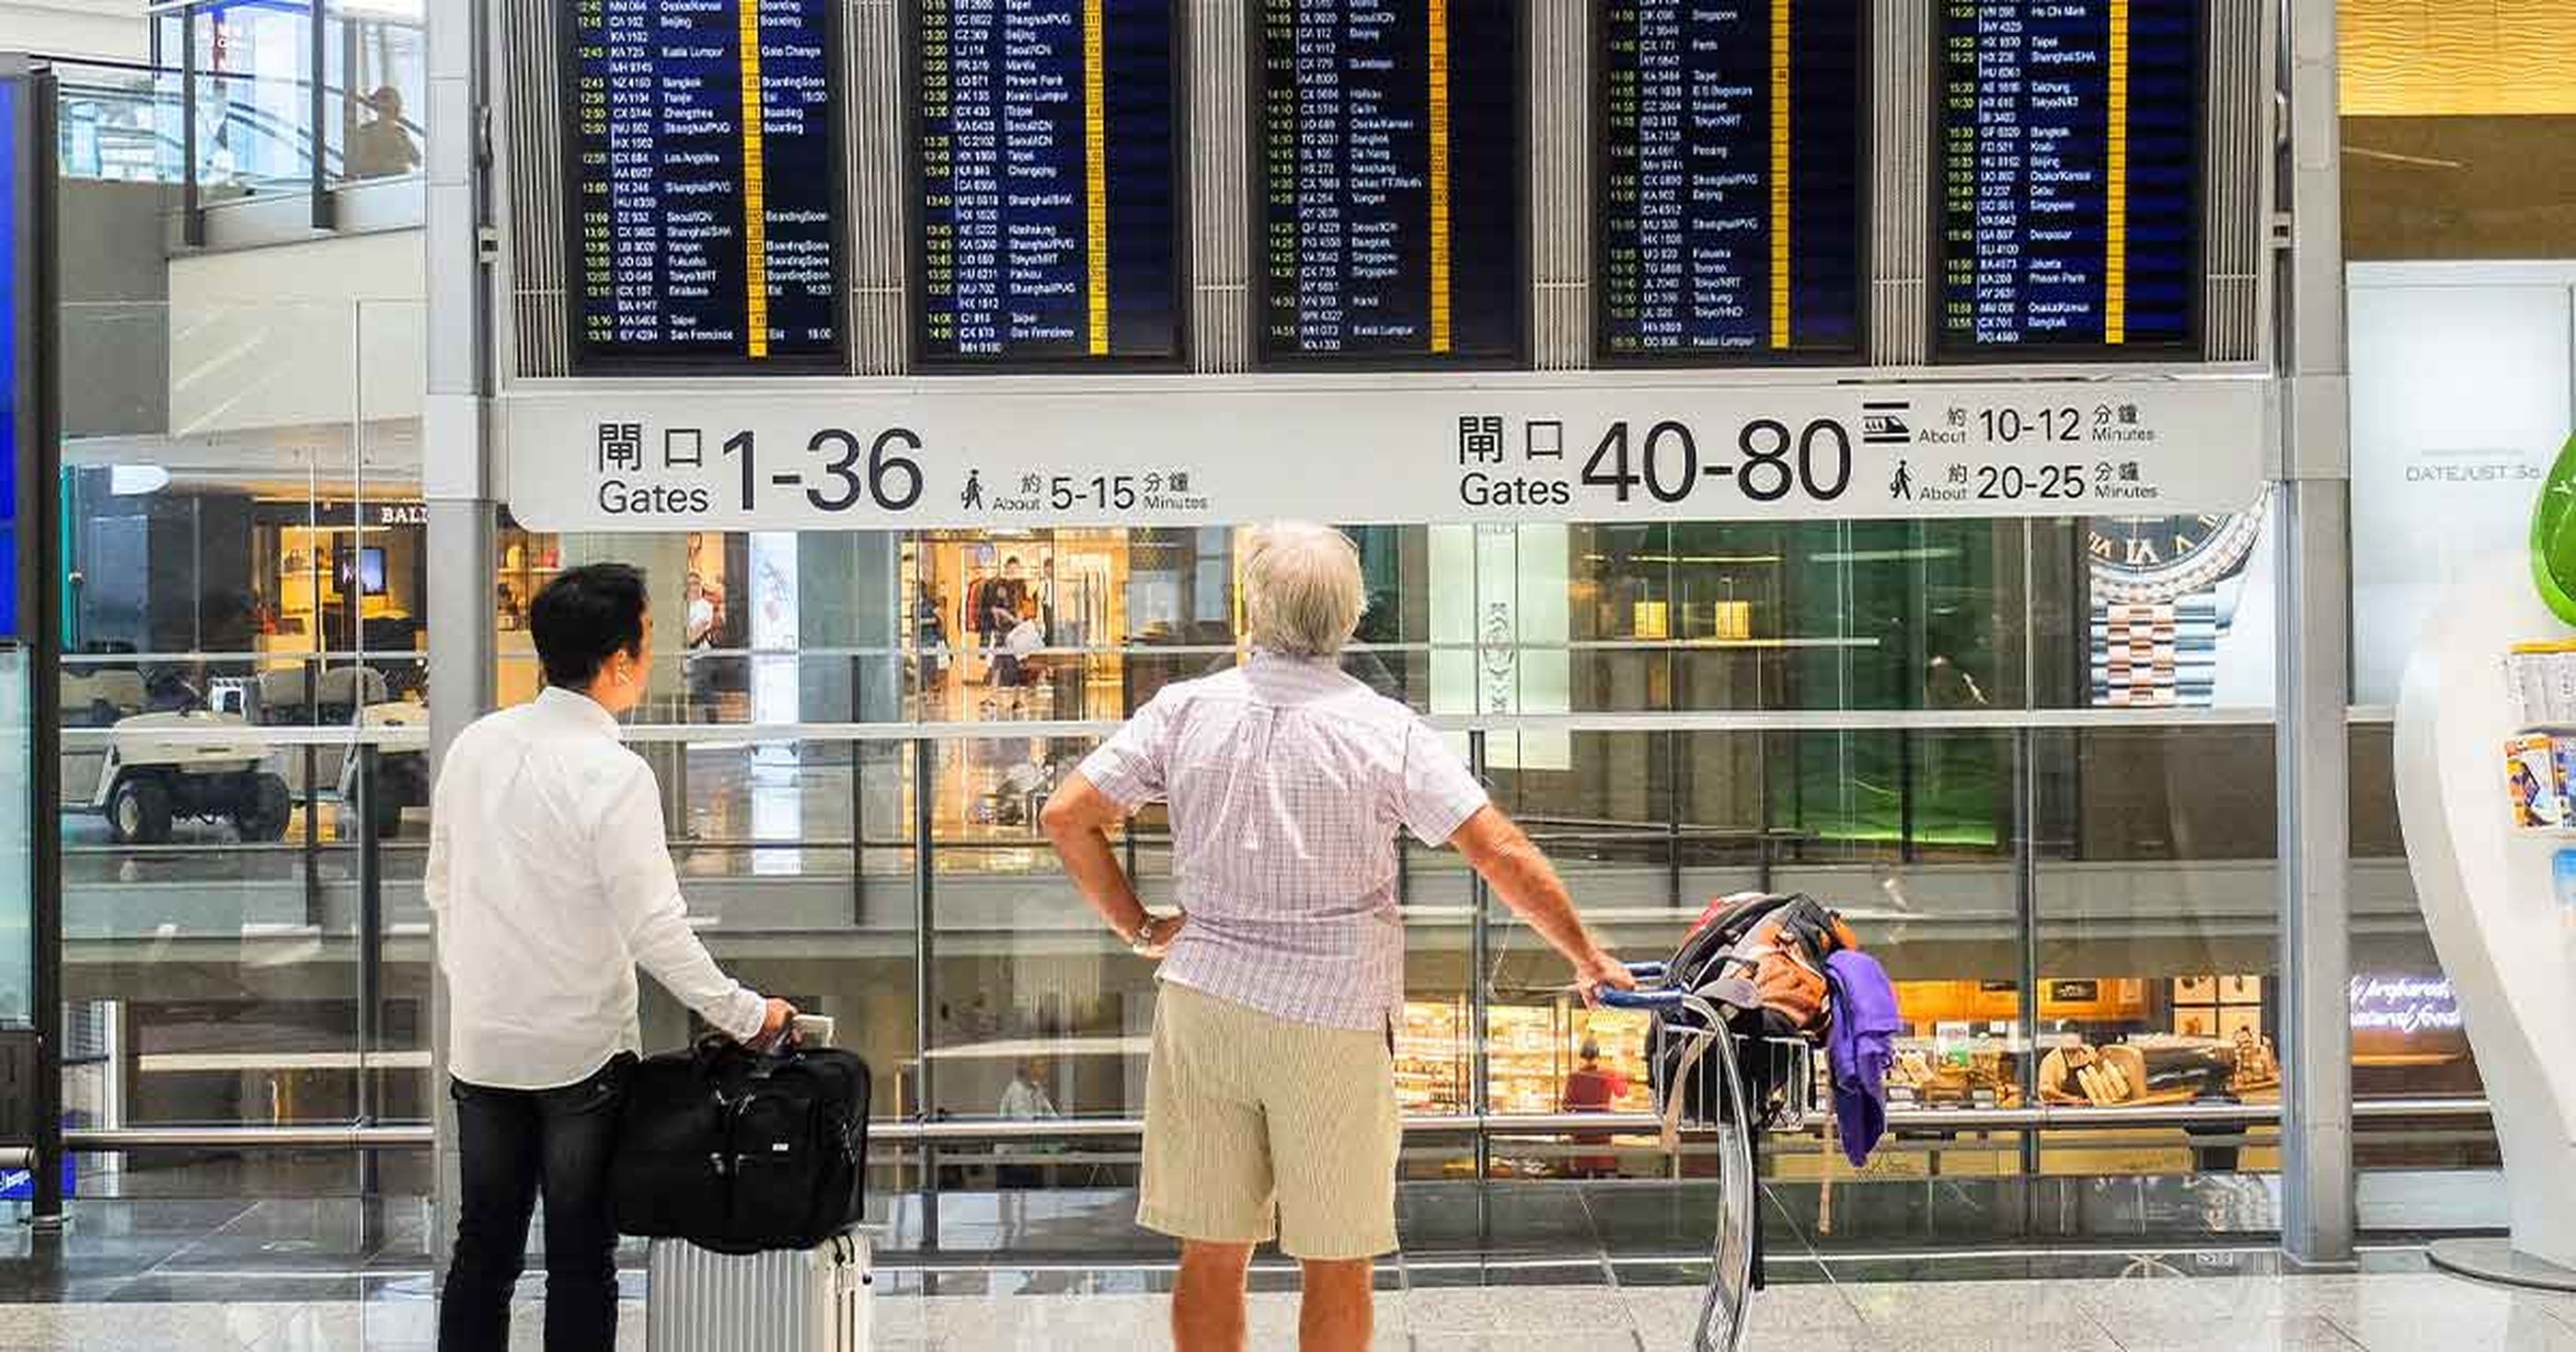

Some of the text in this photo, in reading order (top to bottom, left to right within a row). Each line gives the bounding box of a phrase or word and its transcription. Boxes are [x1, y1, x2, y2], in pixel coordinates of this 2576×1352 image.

[1918, 428, 2154, 443] About Minutes
[1979, 407, 2081, 442] 10-12
[722, 428, 924, 512] 1-36
[1581, 418, 1852, 503] 40-80
[599, 479, 709, 514] Gates
[1051, 475, 1135, 510] 5-15
[1459, 472, 1570, 506] Gates
[1919, 485, 2157, 501] About Minutes
[1977, 464, 2086, 499] 20-25
[993, 495, 1206, 510] About Minutes
